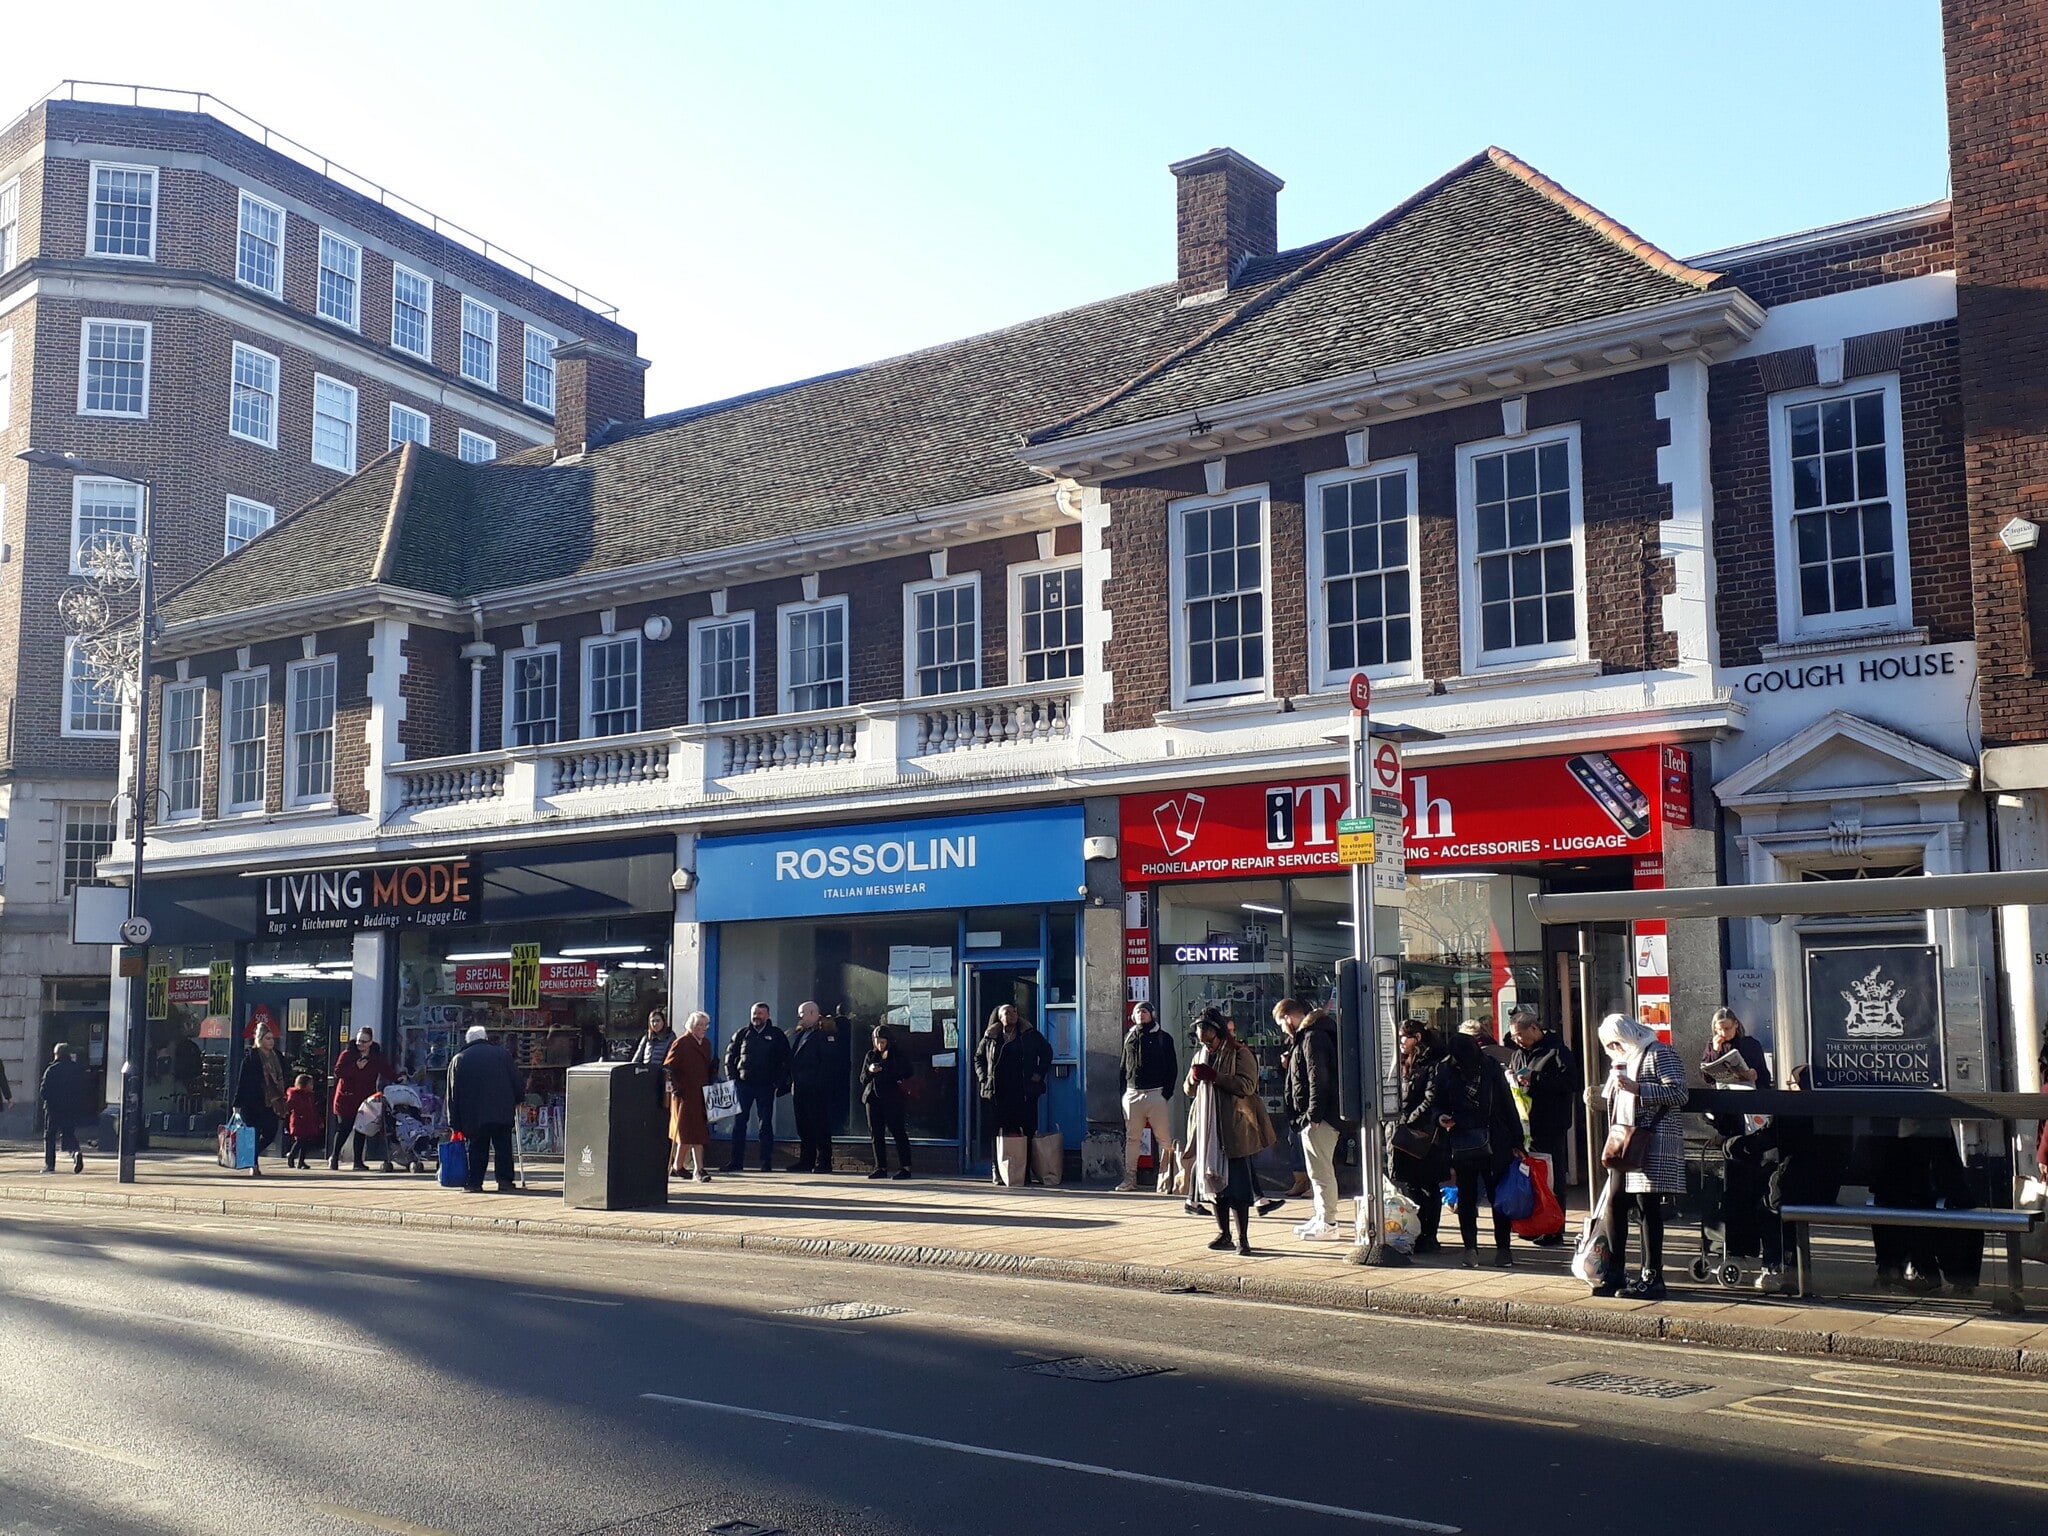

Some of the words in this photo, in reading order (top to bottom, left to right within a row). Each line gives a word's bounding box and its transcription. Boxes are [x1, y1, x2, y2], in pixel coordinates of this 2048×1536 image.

[1744, 663, 1844, 694] GOUGH
[1859, 652, 1955, 682] HOUSE
[1356, 683, 1368, 699] E2
[1663, 748, 1687, 774] iTech
[776, 835, 976, 880] ROSSOLINI
[1141, 859, 1229, 874] PHONE/LAPTOP
[1231, 856, 1275, 870] REPAIR
[1278, 852, 1339, 867] SERVICES
[1440, 840, 1541, 857] ACCESSORIES
[1553, 834, 1628, 851] LUGGAGE
[265, 870, 363, 915] LIVING
[372, 863, 470, 908] MODE
[823, 886, 863, 899] ITALIAN
[865, 883, 926, 896] MENSWEAR
[268, 920, 287, 935] Rugs
[302, 918, 348, 931] Kitchenware
[363, 913, 400, 929] Beddings
[416, 910, 450, 926] Luggage
[453, 908, 467, 922] Etc
[129, 924, 147, 936] 20
[1127, 938, 1136, 946] WE
[512, 945, 538, 960] SAVE
[1127, 947, 1147, 955] PHONES
[1175, 946, 1239, 962] CENTRE
[211, 961, 230, 974] SAVE
[1126, 957, 1135, 965] FOR
[1136, 956, 1149, 965] CASH
[149, 966, 166, 977] SAVE
[466, 968, 503, 981] SPECIAL
[550, 965, 590, 978] SPECIAL
[175, 980, 204, 990] SPECIAL
[455, 981, 484, 992] OPENING
[484, 981, 509, 991] OFFERS
[511, 964, 538, 1006] 50%
[540, 979, 569, 990] OPENING
[569, 978, 597, 988] OFFERS
[148, 982, 167, 1018] 50%
[168, 991, 189, 1000] OPENING
[189, 991, 209, 999] OFFERS
[209, 980, 230, 1016] 50%
[1826, 1043, 1840, 1051] THE
[1843, 1043, 1868, 1051] ROYAL
[1871, 1043, 1914, 1051] BOROUGH
[1826, 1052, 1929, 1069] KINGSTON
[1827, 1070, 1869, 1083] UPON
[1871, 1070, 1930, 1083] THAMES
